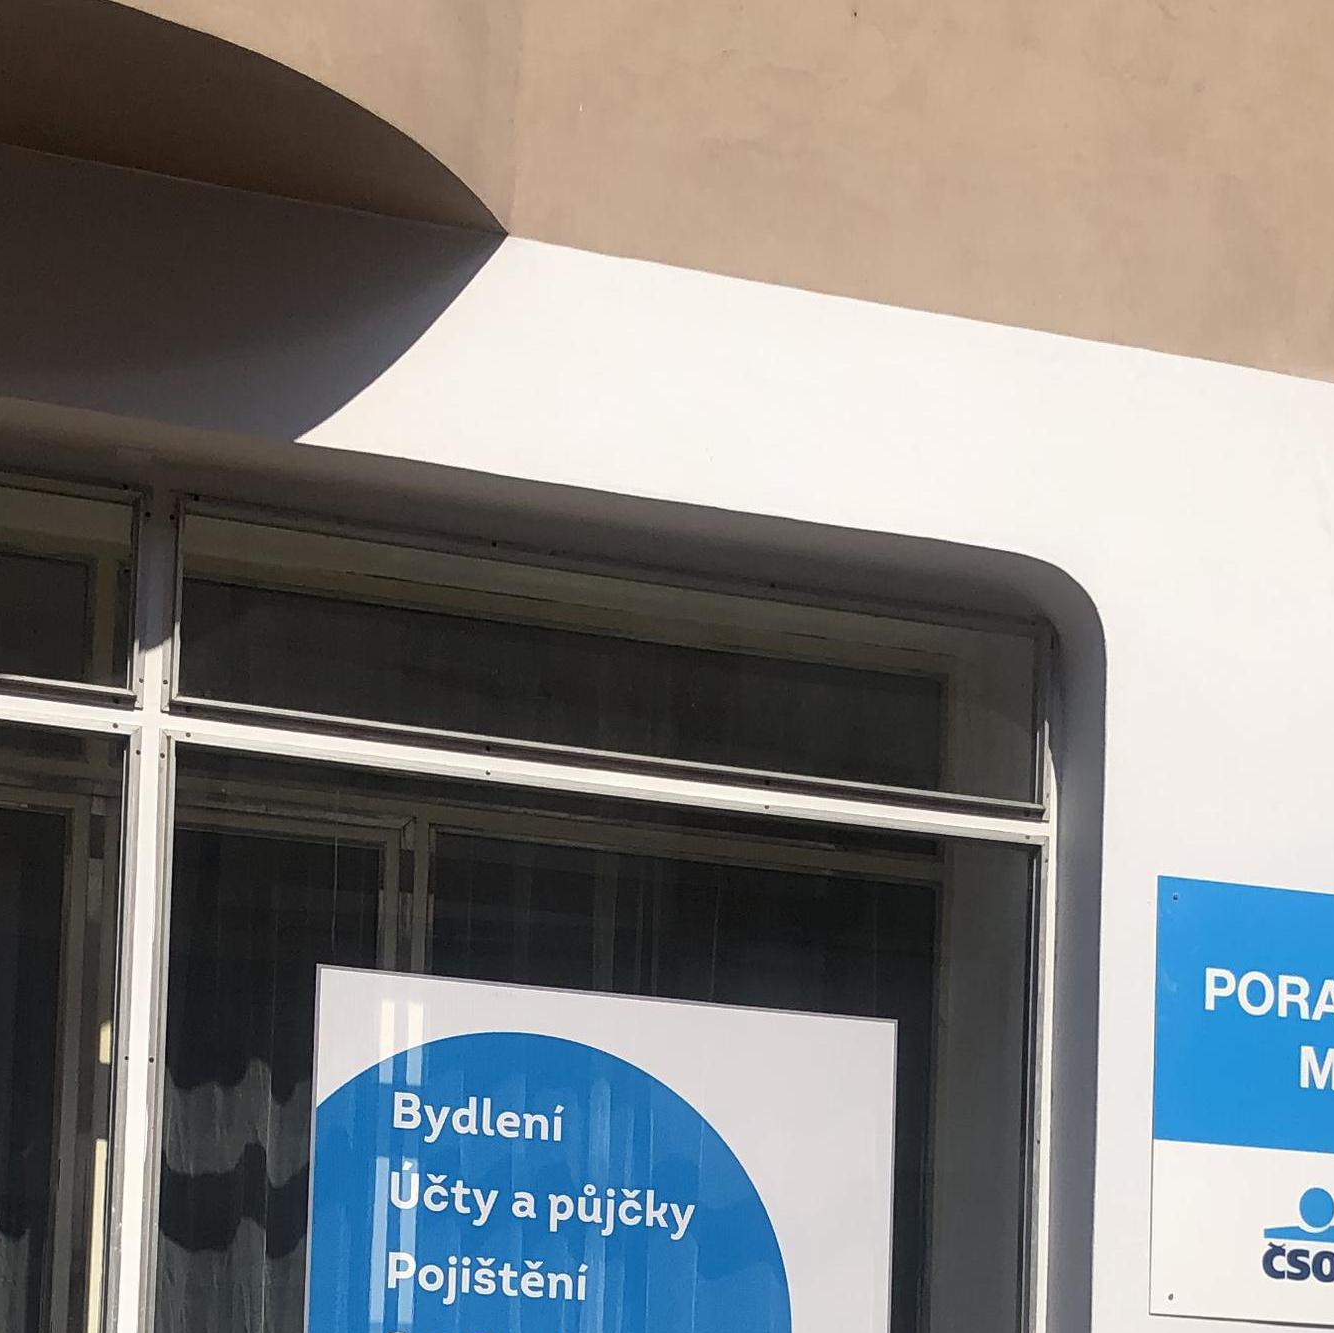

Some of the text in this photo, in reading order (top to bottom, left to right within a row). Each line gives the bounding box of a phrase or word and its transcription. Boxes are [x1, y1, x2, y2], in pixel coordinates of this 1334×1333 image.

[391, 1091, 564, 1144] Bydlení
[390, 1161, 695, 1241] Účty a půjčky
[386, 1252, 588, 1305] Pojištění
